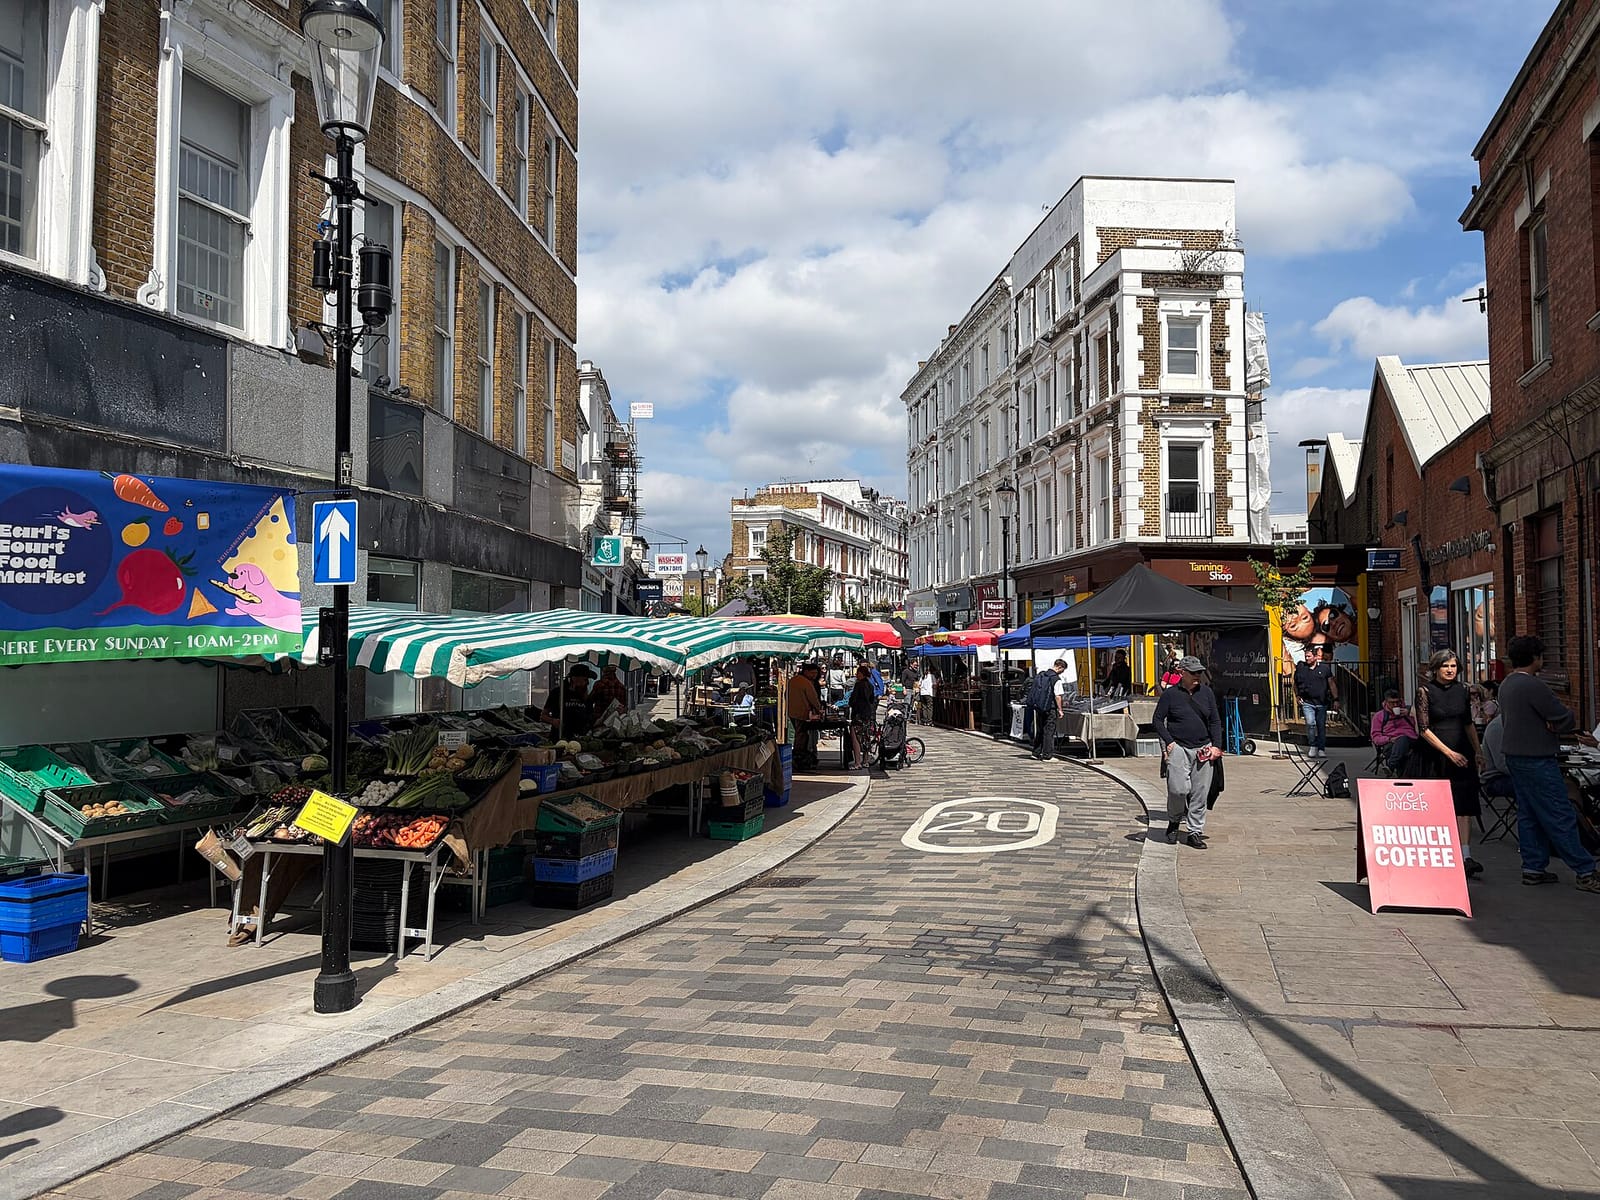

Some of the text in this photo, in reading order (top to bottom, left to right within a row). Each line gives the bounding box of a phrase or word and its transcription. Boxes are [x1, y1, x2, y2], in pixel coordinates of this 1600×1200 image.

[0, 555, 57, 569] Food
[1189, 562, 1224, 573] Tanning
[1209, 572, 1233, 582] Shop
[986, 602, 1007, 610] Masal
[915, 609, 935, 617] pomp
[44, 639, 99, 653] EVERY
[104, 636, 169, 650] SUNDAY
[187, 633, 278, 648] 10AM-2PM
[1385, 801, 1429, 811] UNDER
[923, 811, 1041, 833] 20
[1371, 825, 1452, 845] BRUNCH
[1375, 846, 1456, 867] COFFEE
